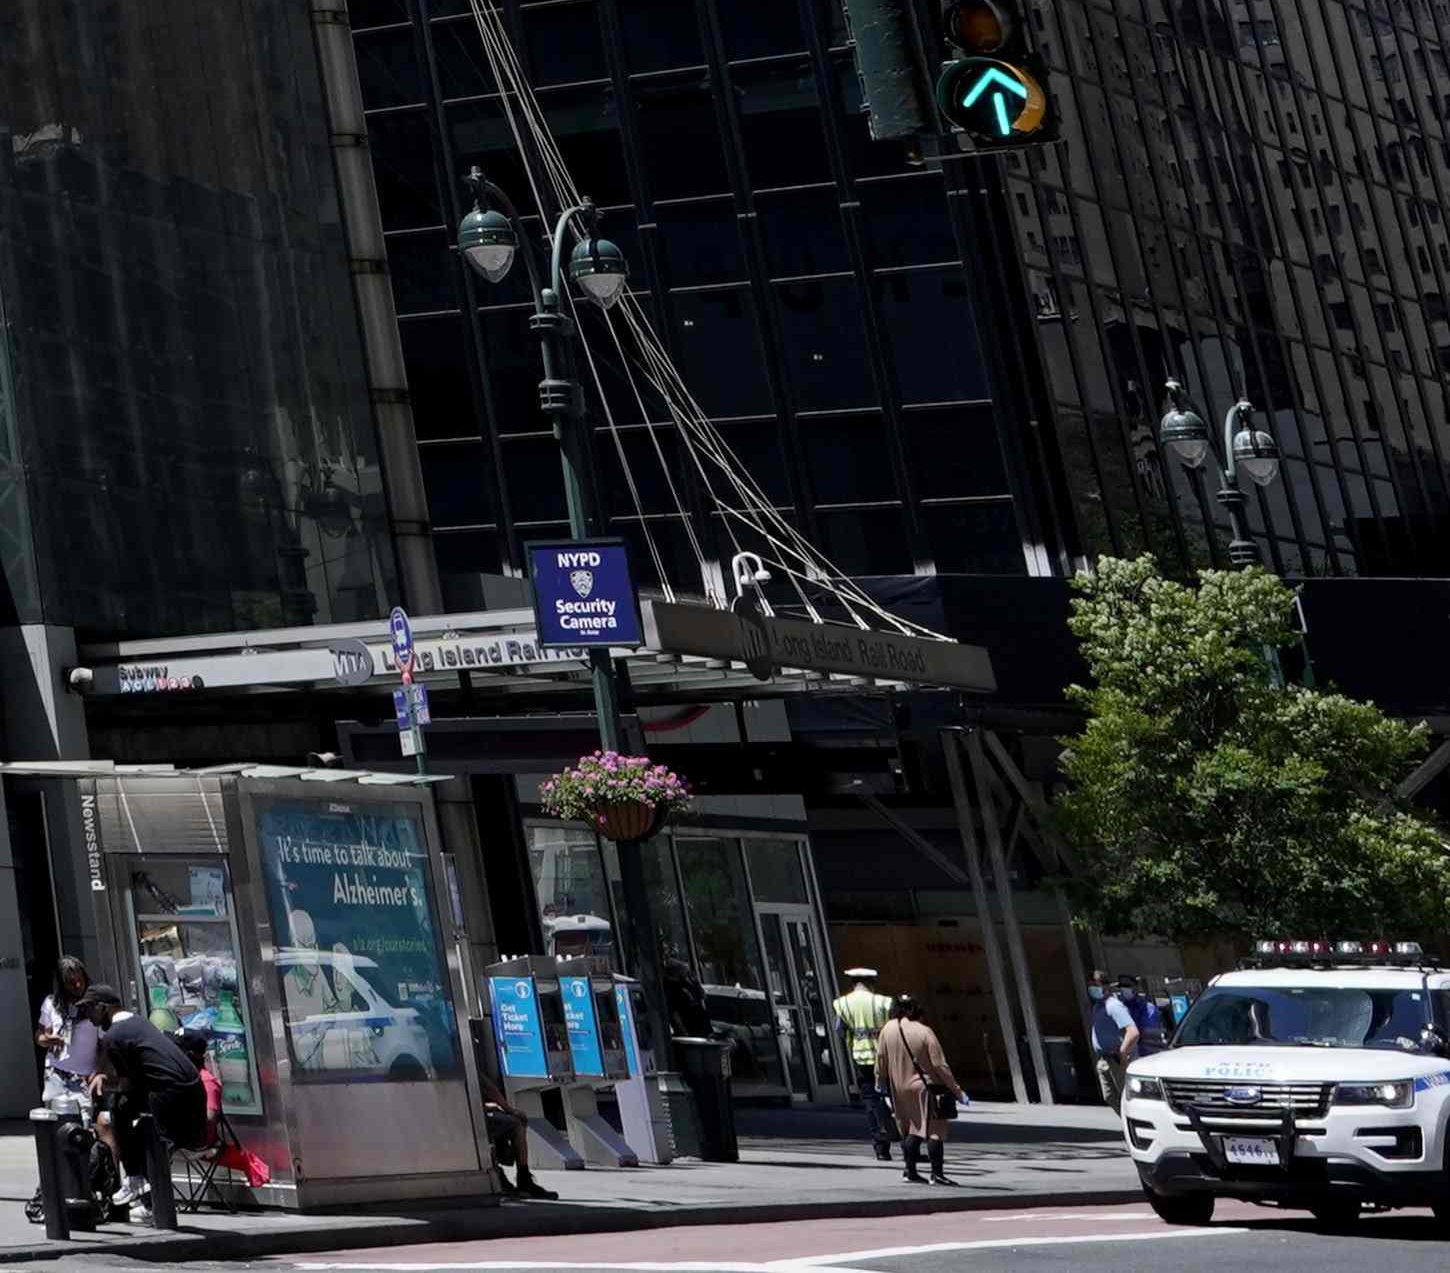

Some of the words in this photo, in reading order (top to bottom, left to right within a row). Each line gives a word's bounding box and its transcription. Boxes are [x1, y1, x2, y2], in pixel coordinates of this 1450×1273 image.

[557, 552, 601, 568] NYPD
[555, 598, 616, 615] Security
[559, 614, 617, 629] Camera
[438, 640, 500, 668] Island
[118, 663, 169, 680] Subway
[80, 794, 106, 892] Newsstand
[277, 835, 300, 863] It's
[302, 838, 332, 865] time
[333, 846, 348, 866] to
[350, 840, 377, 866] talk
[378, 844, 413, 870] about
